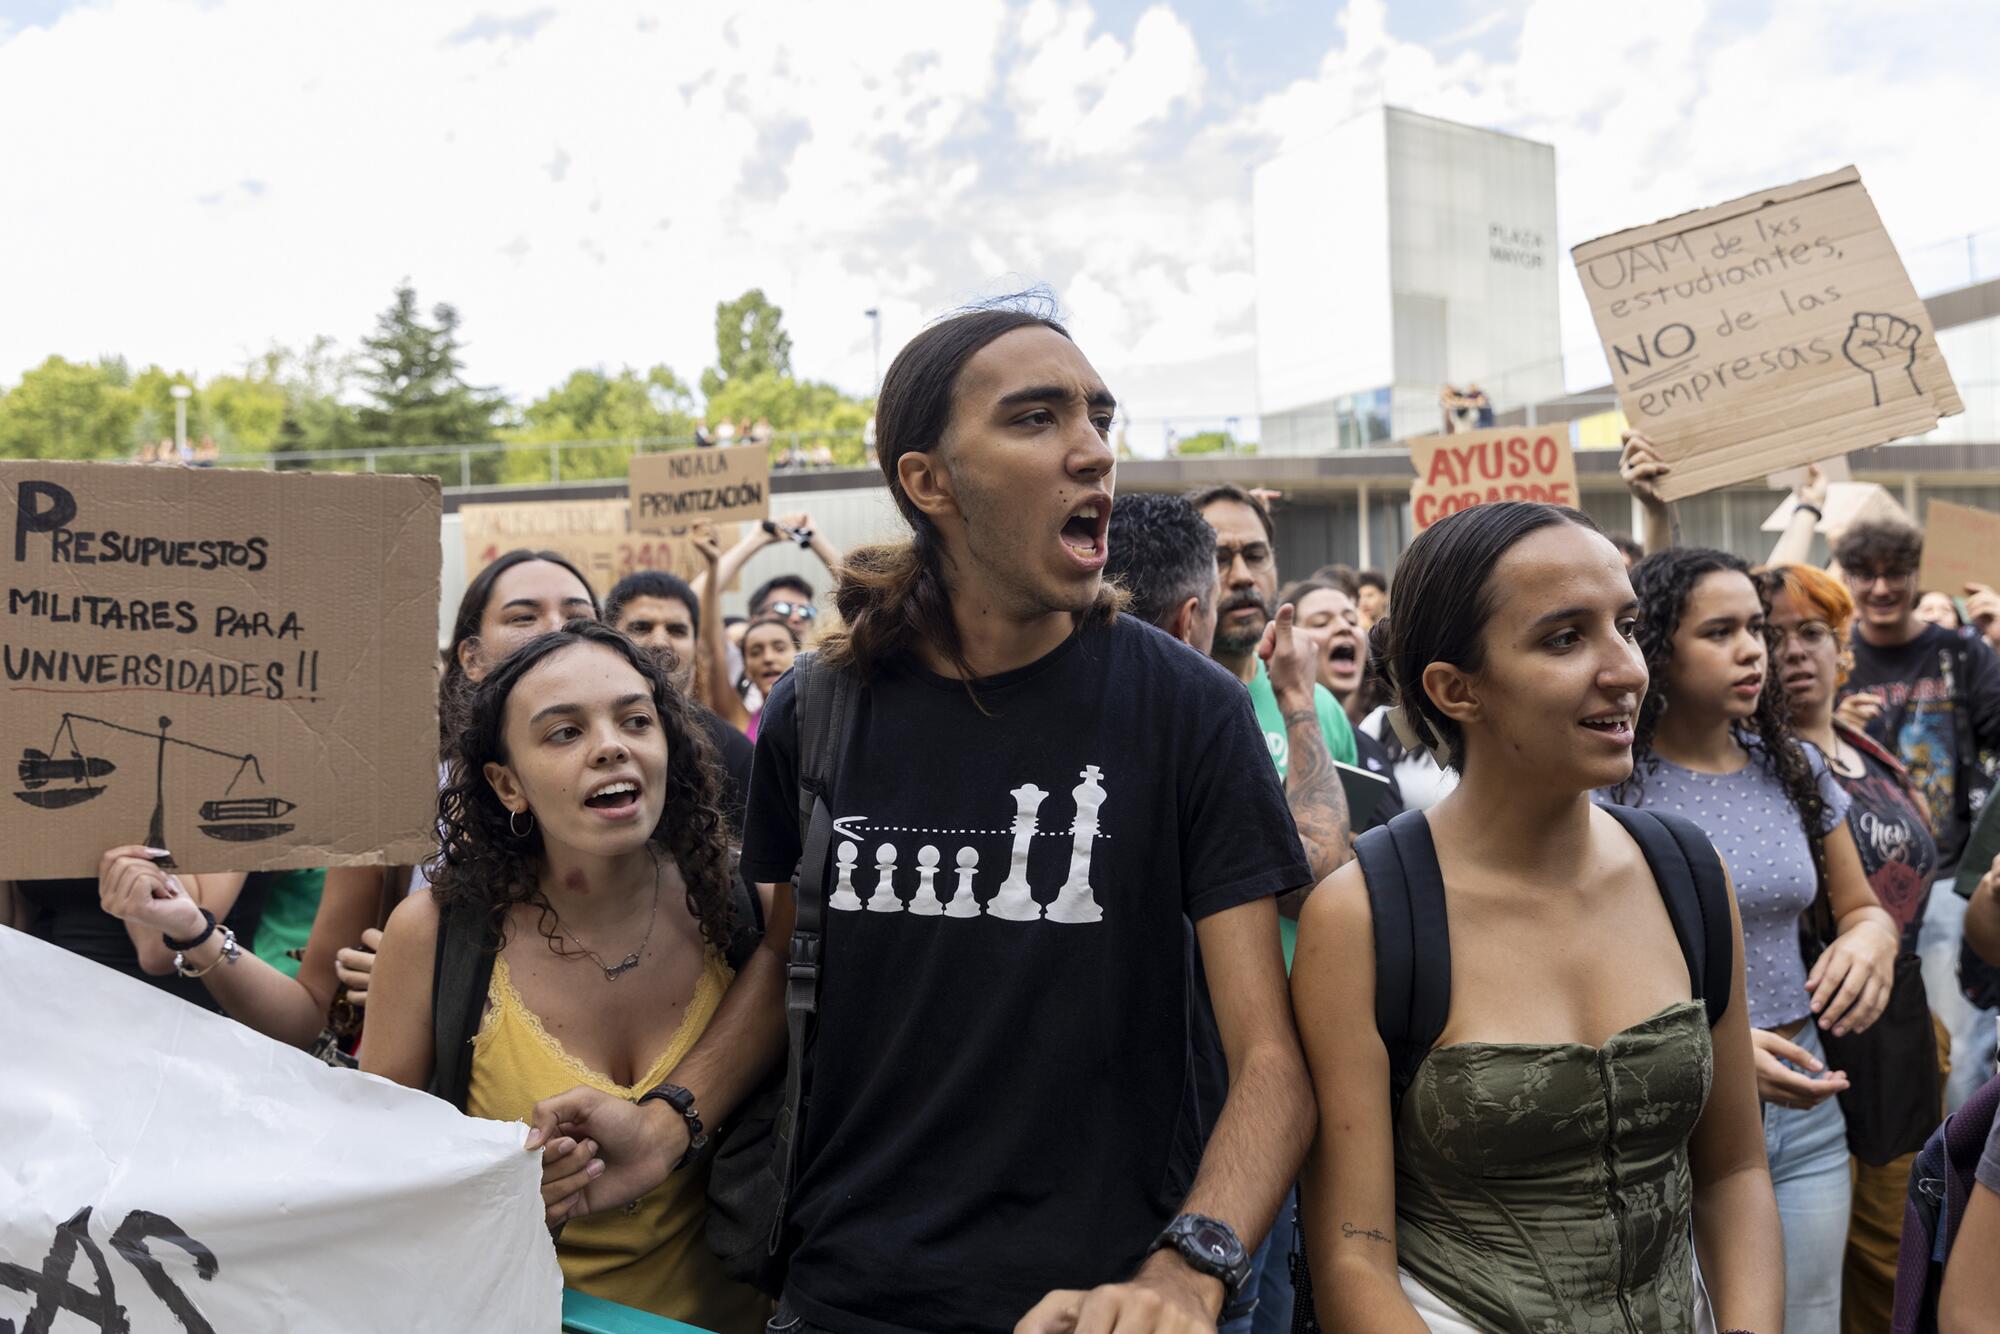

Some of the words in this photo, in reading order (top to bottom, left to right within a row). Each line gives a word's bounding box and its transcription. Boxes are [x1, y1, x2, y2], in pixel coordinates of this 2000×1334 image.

[1488, 222, 1544, 249] PLAZA
[1489, 245, 1545, 270] MAYOR
[1588, 233, 1696, 290] UAM
[1710, 230, 1742, 260] de
[1755, 216, 1802, 242] lxs
[1610, 235, 1843, 319] estudiantes,
[1612, 322, 1696, 376] NO
[1716, 309, 1760, 338] de
[1780, 285, 1842, 316] las
[1638, 336, 1833, 418] empresas
[669, 455, 692, 479] NO
[707, 451, 729, 475] LA
[1426, 435, 1559, 487] AYUSO
[639, 477, 763, 518] PRIVATIZACIÓN
[14, 480, 270, 571] PRESUPUESTOS
[8, 588, 199, 634] MILITARES
[214, 606, 305, 640] PARA
